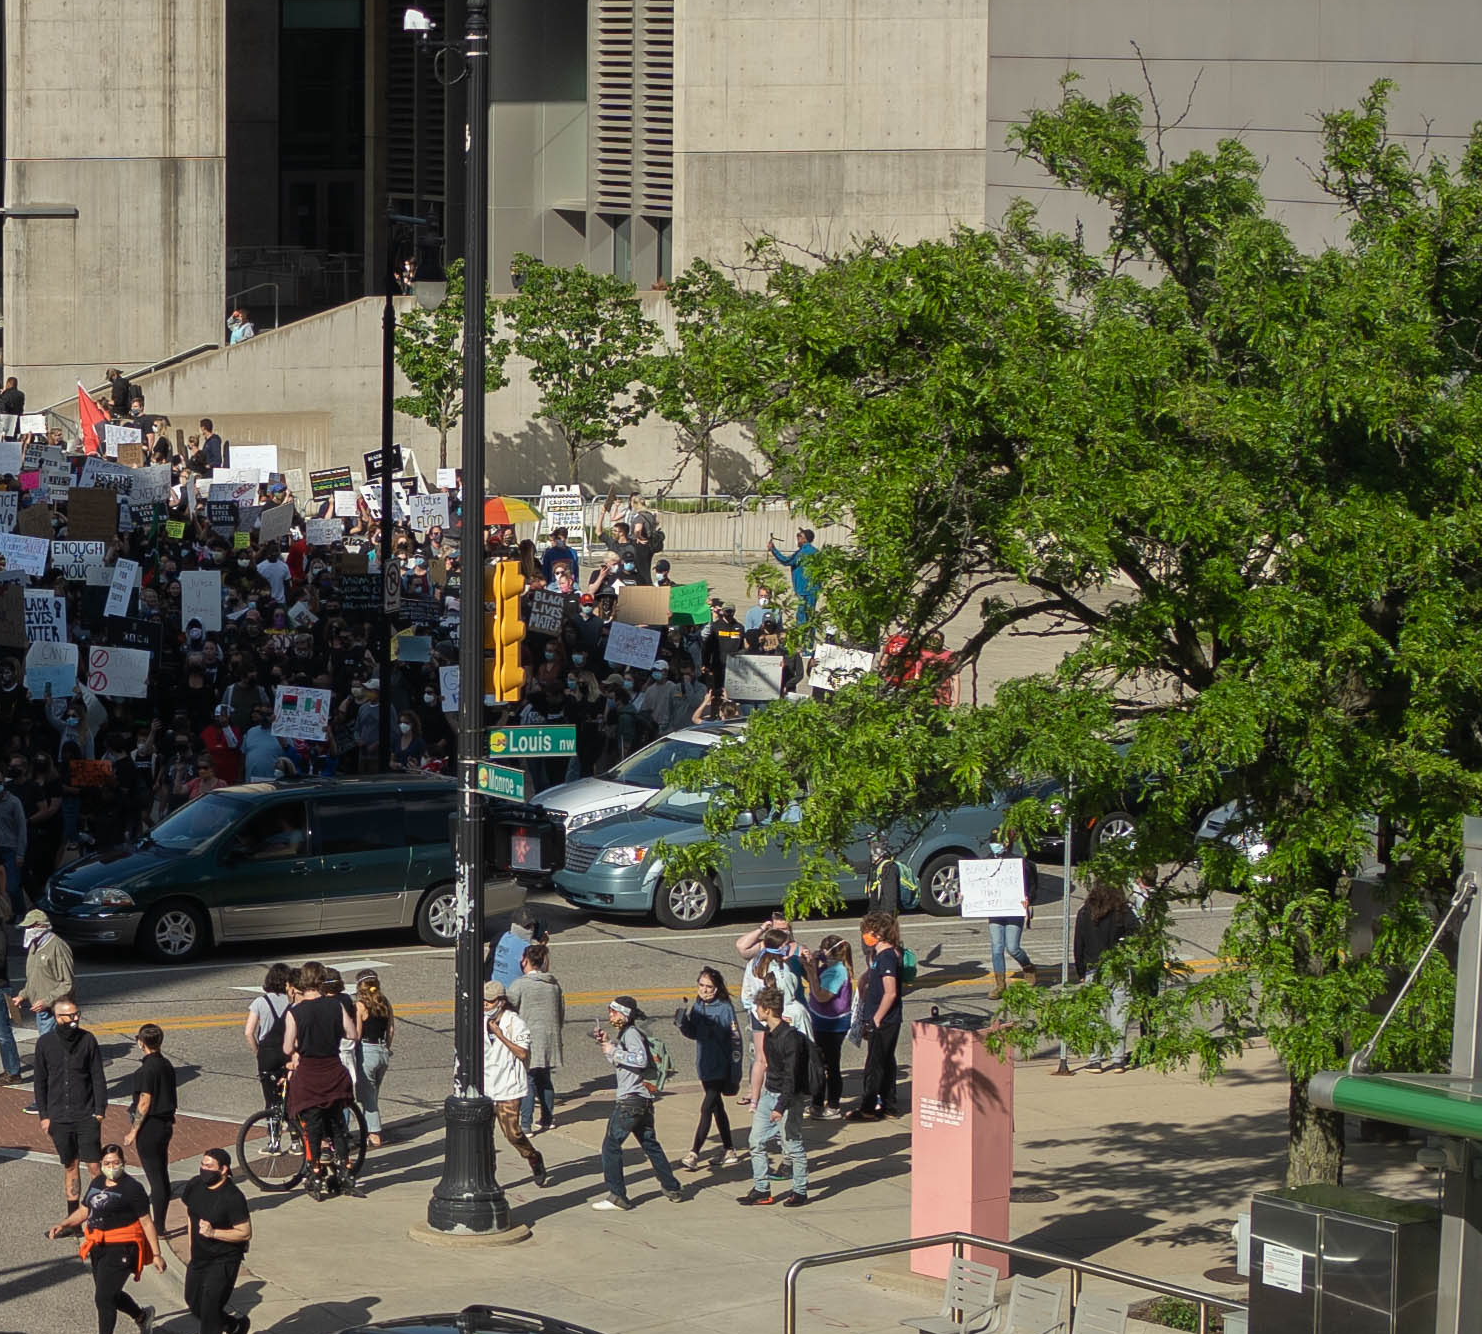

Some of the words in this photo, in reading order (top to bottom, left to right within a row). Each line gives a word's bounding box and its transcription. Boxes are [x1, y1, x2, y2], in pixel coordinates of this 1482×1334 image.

[53, 542, 103, 555] ENOUGH
[534, 590, 564, 605] BLACK
[533, 604, 563, 619] LIVES
[528, 614, 562, 633] MATTER
[509, 730, 552, 752] Louis
[488, 768, 514, 795] Monroe
